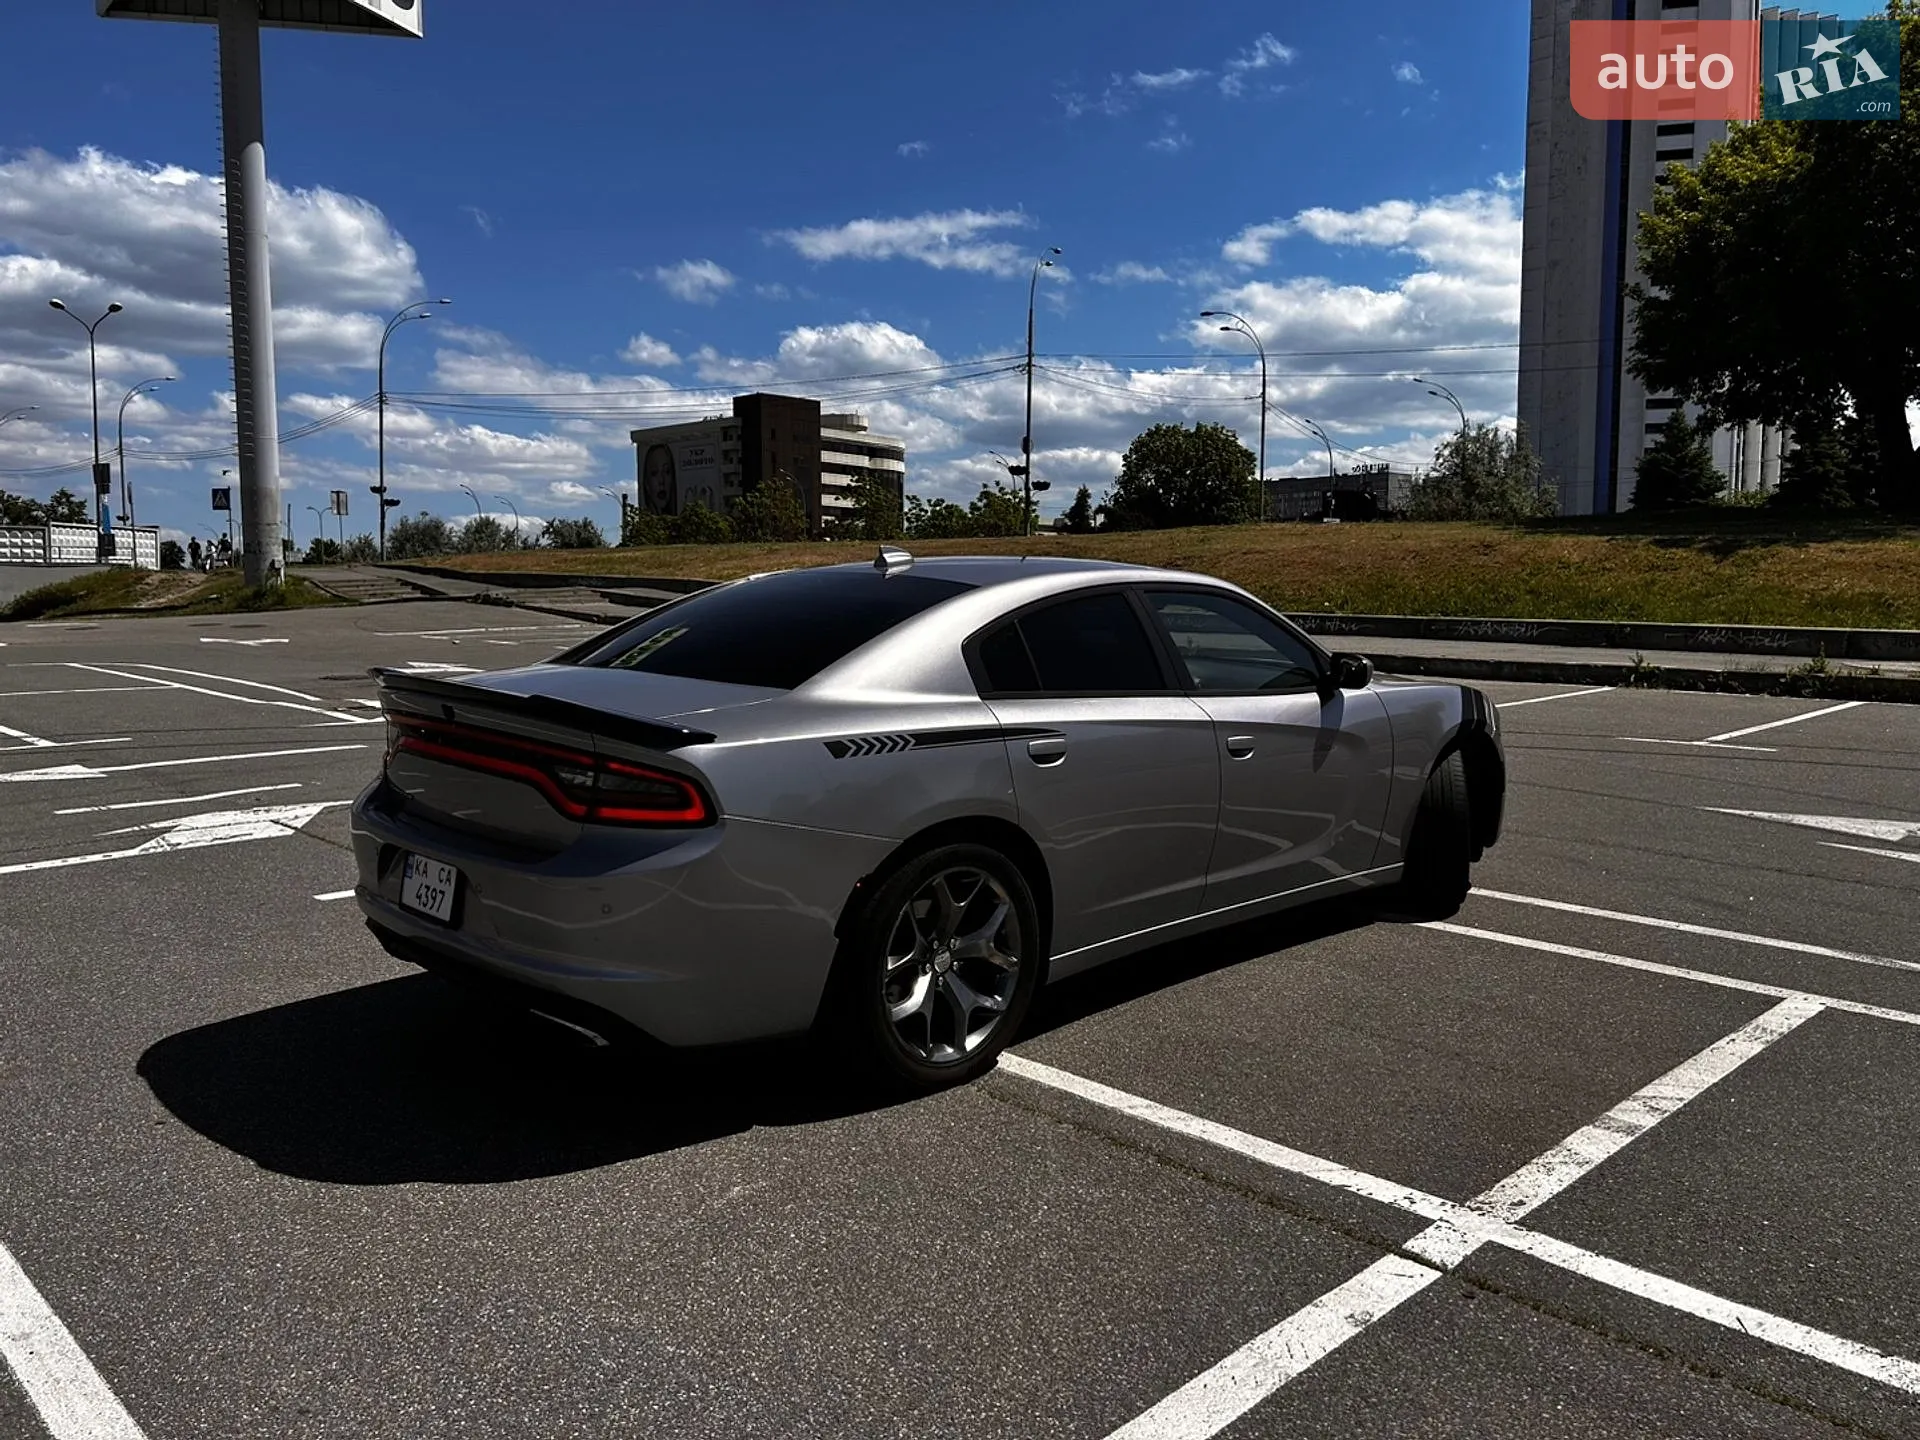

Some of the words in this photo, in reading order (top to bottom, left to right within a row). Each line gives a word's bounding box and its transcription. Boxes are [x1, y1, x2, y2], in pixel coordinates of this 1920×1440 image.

[414, 858, 428, 880] KA
[440, 868, 452, 886] CA
[416, 883, 446, 912] 4397
